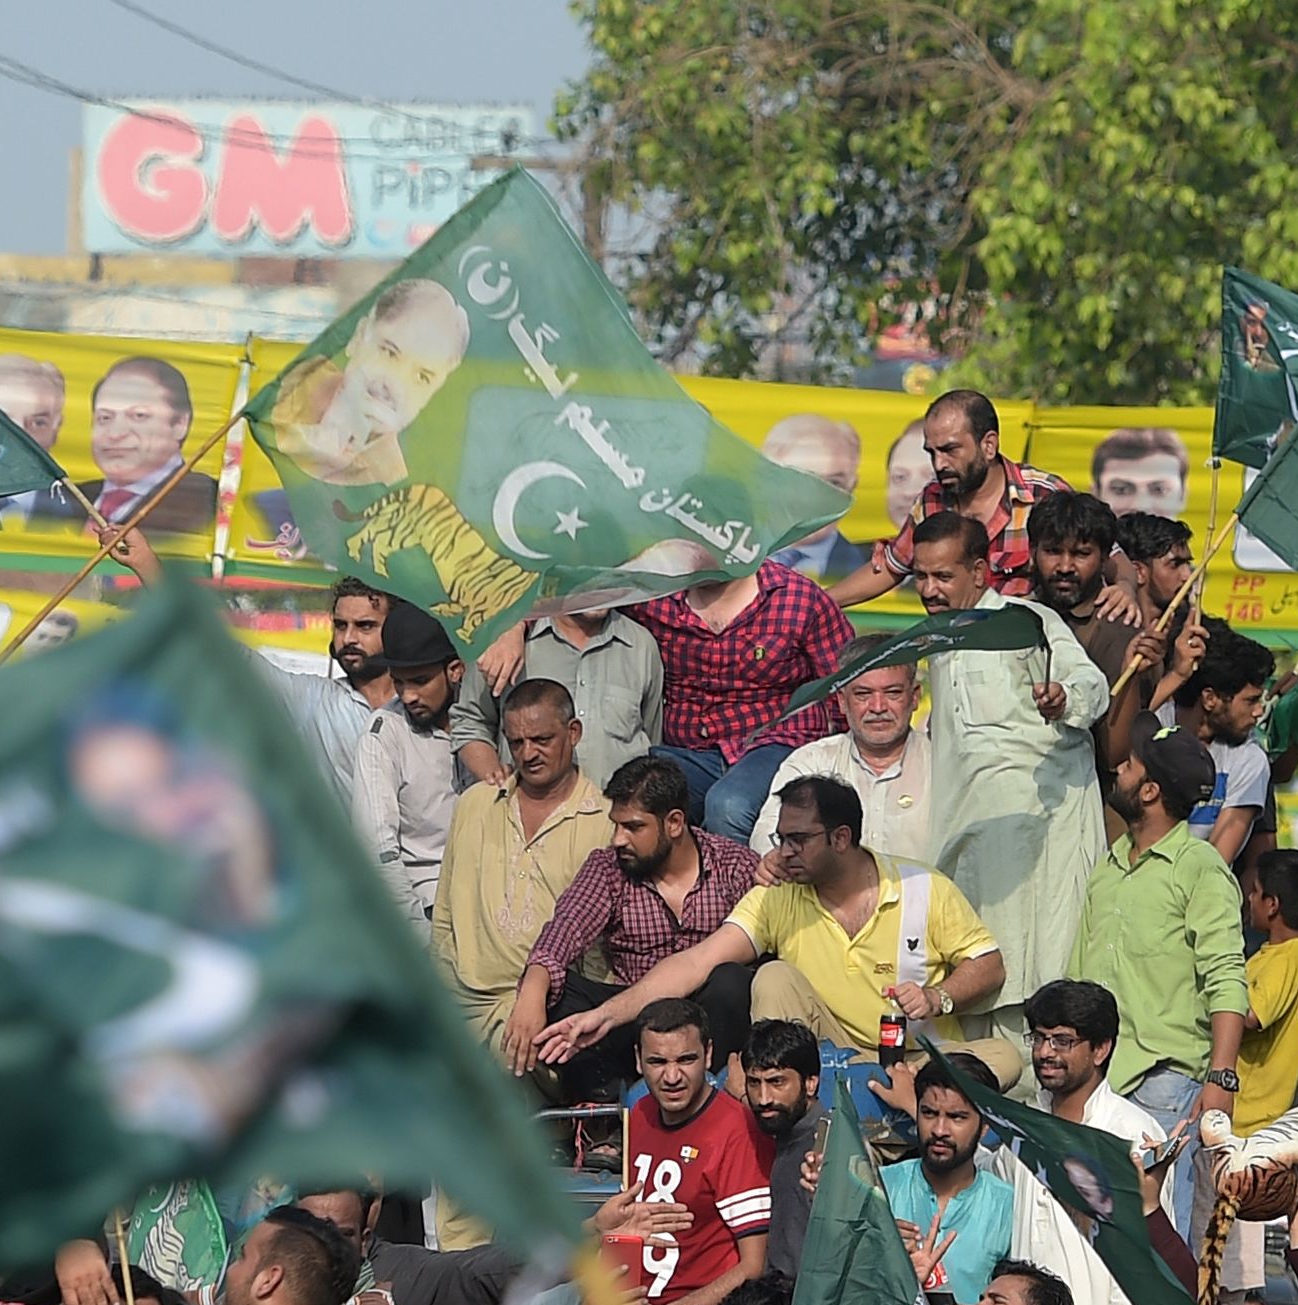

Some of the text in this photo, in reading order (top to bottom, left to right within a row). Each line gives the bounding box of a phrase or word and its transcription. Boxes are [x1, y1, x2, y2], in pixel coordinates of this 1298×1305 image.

[97, 108, 352, 248] GM
[507, 312, 579, 400] لیگ
[555, 401, 645, 489] مسلم
[639, 488, 761, 564] پاکستان
[1224, 603, 1263, 622] 146
[1232, 575, 1265, 591] PP
[634, 1153, 682, 1203] 18
